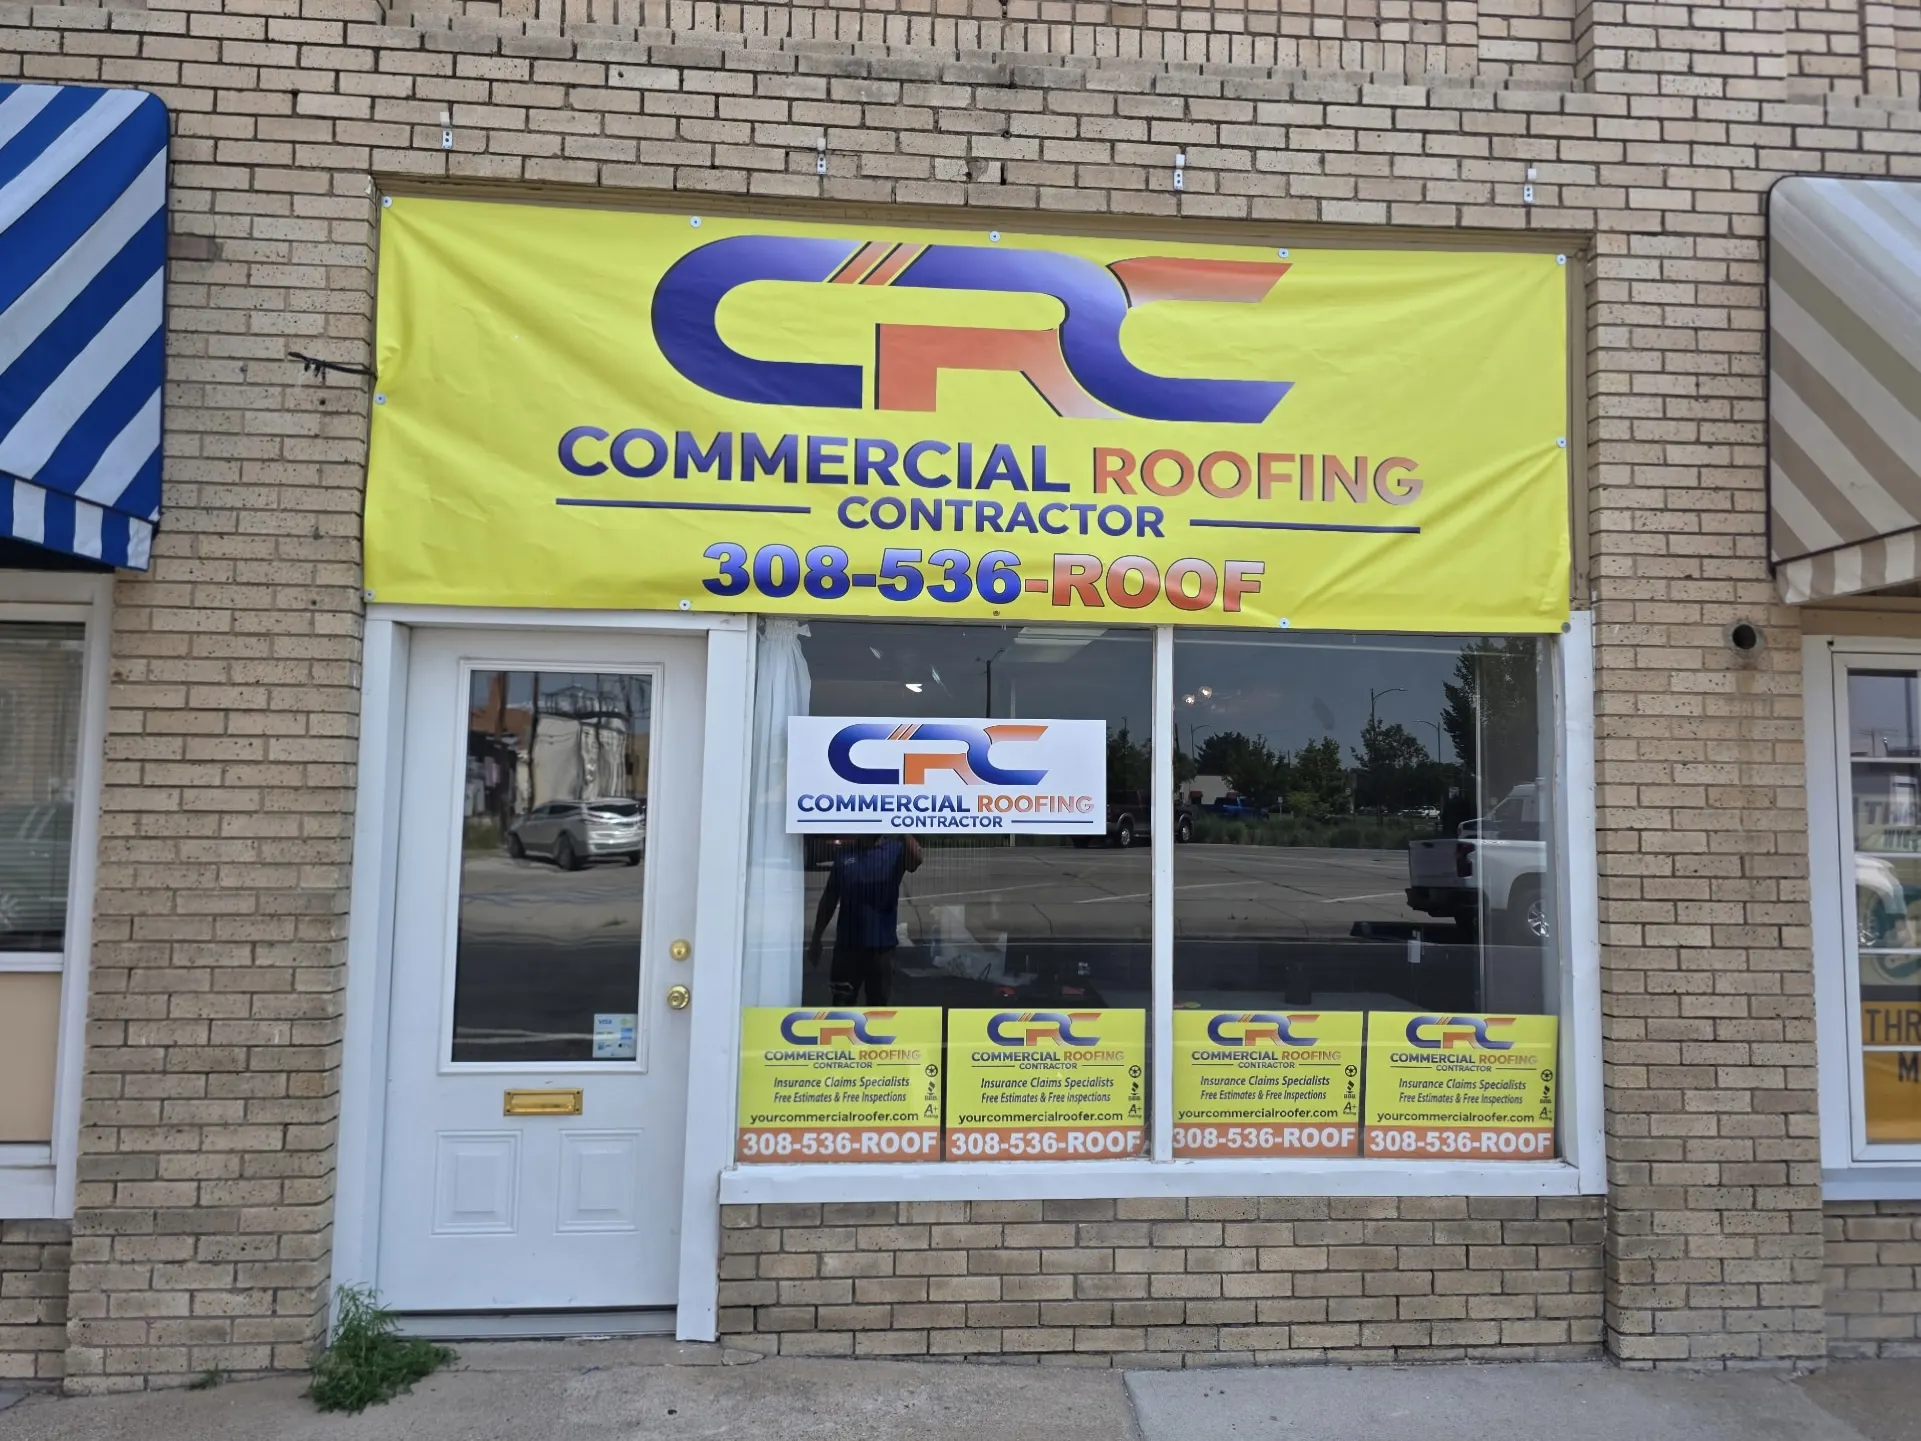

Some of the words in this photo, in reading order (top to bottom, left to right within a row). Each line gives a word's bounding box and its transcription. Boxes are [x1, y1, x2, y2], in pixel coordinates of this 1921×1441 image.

[651, 235, 1294, 424] CRC
[557, 426, 1070, 493] COMMERCIAL
[1093, 447, 1424, 506] ROOFING
[837, 496, 1165, 537] CONTRACTOR
[702, 542, 1265, 612] 308-536-ROOF
[828, 723, 1049, 785] CRC
[797, 793, 970, 813] COMMERCIAL
[977, 794, 1095, 814] ROOFING
[891, 815, 1003, 828] CONTRACTOR
[780, 1011, 898, 1045] CRC
[987, 1013, 1102, 1046] CRC
[1208, 1014, 1320, 1046] CRC
[1406, 1016, 1516, 1050] CRC
[765, 1050, 855, 1061] COMMERCIAL
[859, 1050, 921, 1060] ROOFING
[972, 1052, 1060, 1062] COMMERCIAL
[1064, 1051, 1124, 1061] ROOFING
[1192, 1051, 1278, 1061] COMMERCIAL
[1282, 1051, 1341, 1060] ROOFING
[1390, 1053, 1475, 1064] COMMERCIAL
[1479, 1055, 1537, 1065] ROOFING
[774, 1077, 821, 1088] Insurance
[825, 1077, 856, 1087] Claims
[860, 1077, 909, 1089] Specialists
[981, 1078, 1027, 1088] Insurance
[1030, 1077, 1061, 1088] Claims
[1064, 1077, 1114, 1090] Specialists
[1201, 1076, 1245, 1085] Insurance
[1249, 1076, 1279, 1085] Claims
[1282, 1076, 1330, 1088] Specialists
[1399, 1078, 1443, 1089] Insurance
[1446, 1079, 1476, 1089] Claims
[1479, 1080, 1526, 1091] Specialists
[774, 1093, 792, 1102] Free
[794, 1092, 831, 1102] Estimates
[834, 1093, 840, 1102] &
[842, 1092, 859, 1102] Free
[862, 1092, 906, 1104] Inspections
[981, 1093, 998, 1103] Free
[1001, 1093, 1038, 1103] Estimates
[1040, 1093, 1046, 1102] &
[1048, 1092, 1064, 1102] Free
[1067, 1092, 1110, 1104] Inspections
[1201, 1090, 1218, 1100] Free
[1219, 1090, 1256, 1100] Estimates
[1258, 1090, 1263, 1099] &
[1266, 1090, 1282, 1099] Free
[1284, 1090, 1326, 1102] Inspections
[1399, 1093, 1416, 1102] Free
[1418, 1093, 1453, 1103] Estimates
[1455, 1094, 1461, 1103] &
[1463, 1094, 1478, 1104] Free
[1481, 1094, 1522, 1106] Inspections
[750, 1111, 918, 1124] yourcommercialroofer.com
[959, 1111, 1123, 1124] yourcommercialroofer.com
[1178, 1108, 1338, 1119] yourcommercialroofer.com
[1377, 1112, 1534, 1122] yourcommercialroofer.com
[743, 1132, 937, 1155] 308-536-ROOF
[952, 1131, 1141, 1155] 308-536-ROOF
[1173, 1127, 1355, 1148] 308-536-ROOF
[1370, 1131, 1551, 1153] 308-536-ROOF
